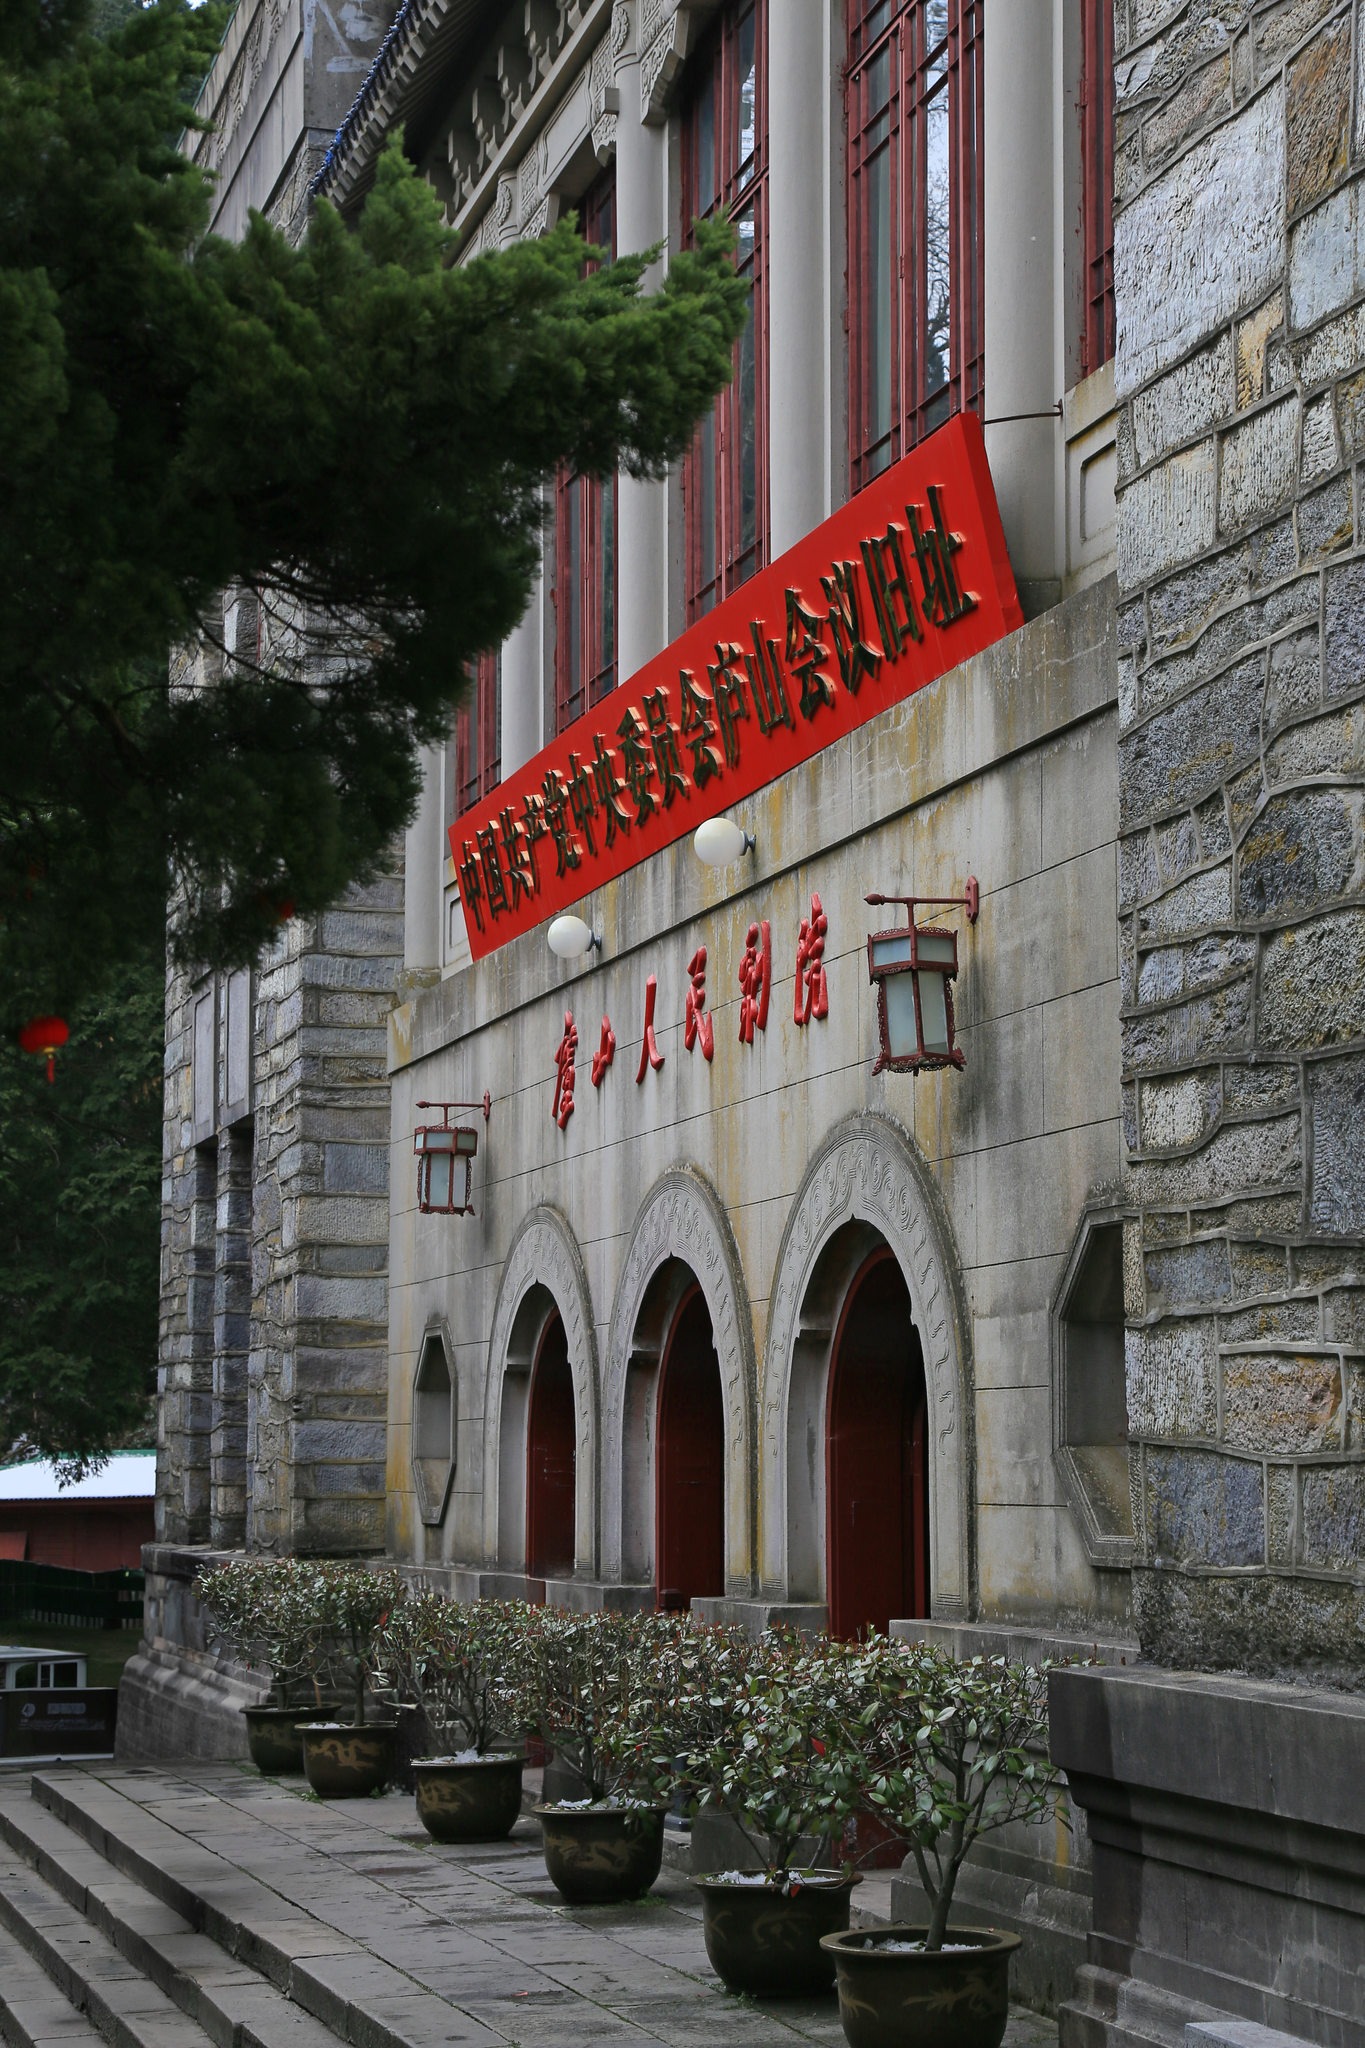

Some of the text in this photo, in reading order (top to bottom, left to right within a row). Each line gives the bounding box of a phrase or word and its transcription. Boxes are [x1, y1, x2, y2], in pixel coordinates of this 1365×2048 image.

[460, 484, 979, 931] 中国共产党中央委员会庐山会议旧址
